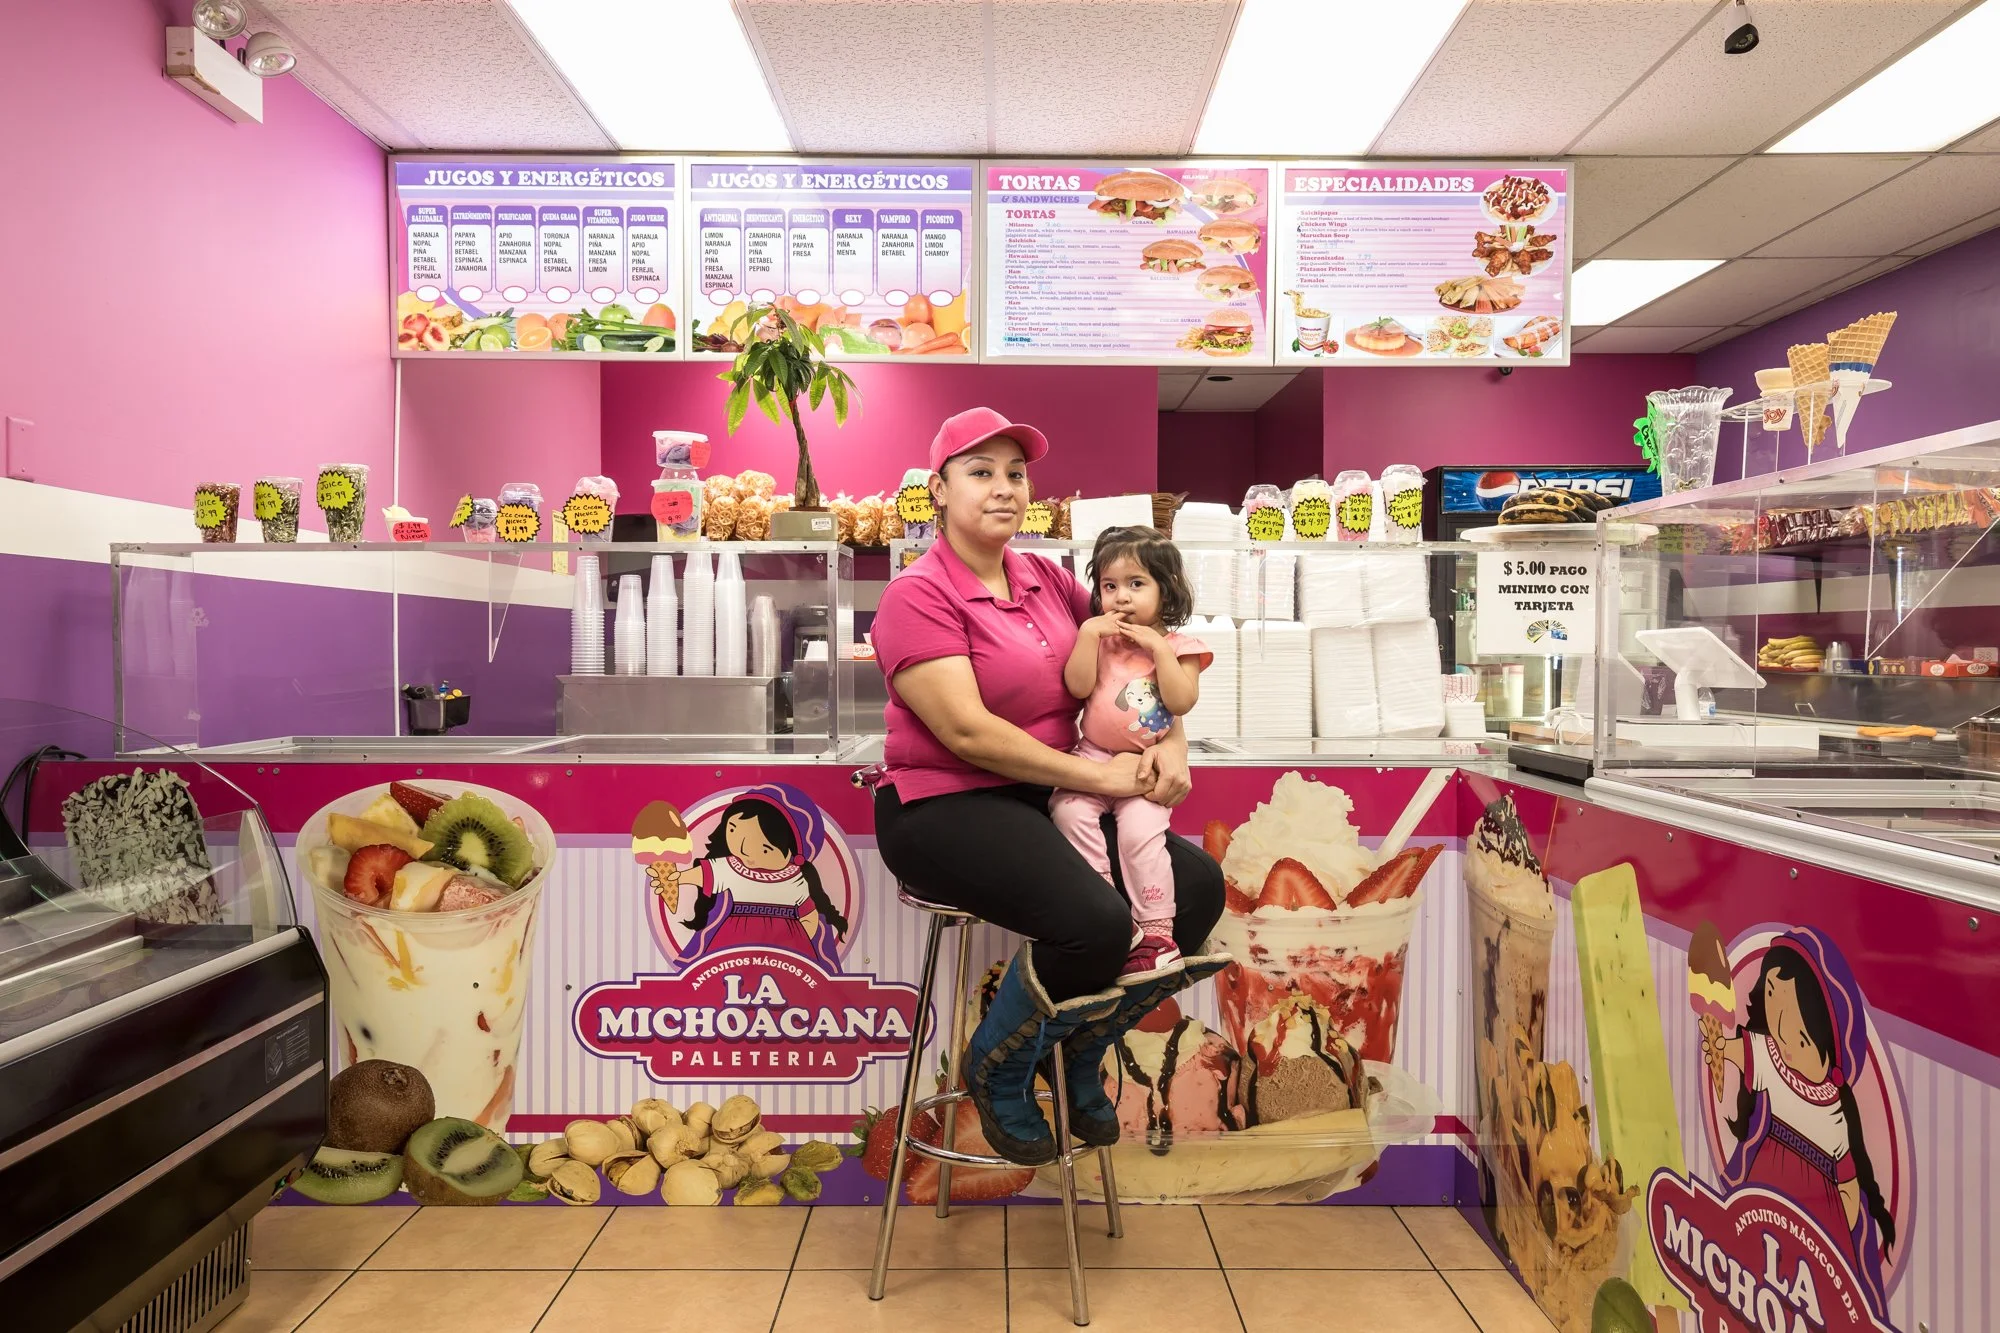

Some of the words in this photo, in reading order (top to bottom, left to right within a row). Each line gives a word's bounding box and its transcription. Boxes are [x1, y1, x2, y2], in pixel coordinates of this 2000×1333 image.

[424, 170, 495, 186] JUGOS
[499, 170, 513, 186] Y
[517, 168, 665, 187] ENERGÉTICOS
[707, 172, 778, 189] JUGOS
[783, 173, 797, 189] Y
[800, 171, 949, 190] ENERGÉTICOS
[998, 175, 1081, 191] TORTAS
[1294, 176, 1475, 192] ESPECIALIDADES
[1001, 195, 1010, 204] &
[1012, 195, 1080, 204] SANDWICHES
[411, 215, 443, 223] SALUDABLE
[542, 213, 559, 221] QUEMA
[647, 214, 665, 222] VERDE
[844, 214, 862, 223] SEXY
[880, 214, 911, 224] VAMPIRO
[926, 215, 954, 224] PICOSITO
[1005, 209, 1056, 219] TORTAS
[319, 479, 343, 489] Juice
[197, 498, 217, 507] Juice
[1503, 561, 1513, 576] $
[1516, 561, 1546, 576] 5.00
[1549, 566, 1588, 576] PAGO
[1498, 584, 1557, 595] MINIMO
[1560, 584, 1590, 595] CON
[1514, 601, 1575, 613] TARJETA
[690, 957, 751, 990] ANTOJITOS
[752, 955, 804, 977] MÁGICOS
[802, 972, 819, 990] DE
[723, 974, 787, 1005] LA
[597, 1007, 912, 1039] MICHOACANA
[671, 1051, 838, 1067] PALETERIA
[1662, 1203, 1808, 1333] MICHO
[1735, 1208, 1788, 1237] ANTOJITOS
[1788, 1220, 1843, 1291] MÁGICOS
[1840, 1293, 1860, 1325] DE
[1762, 1232, 1826, 1327] LA
